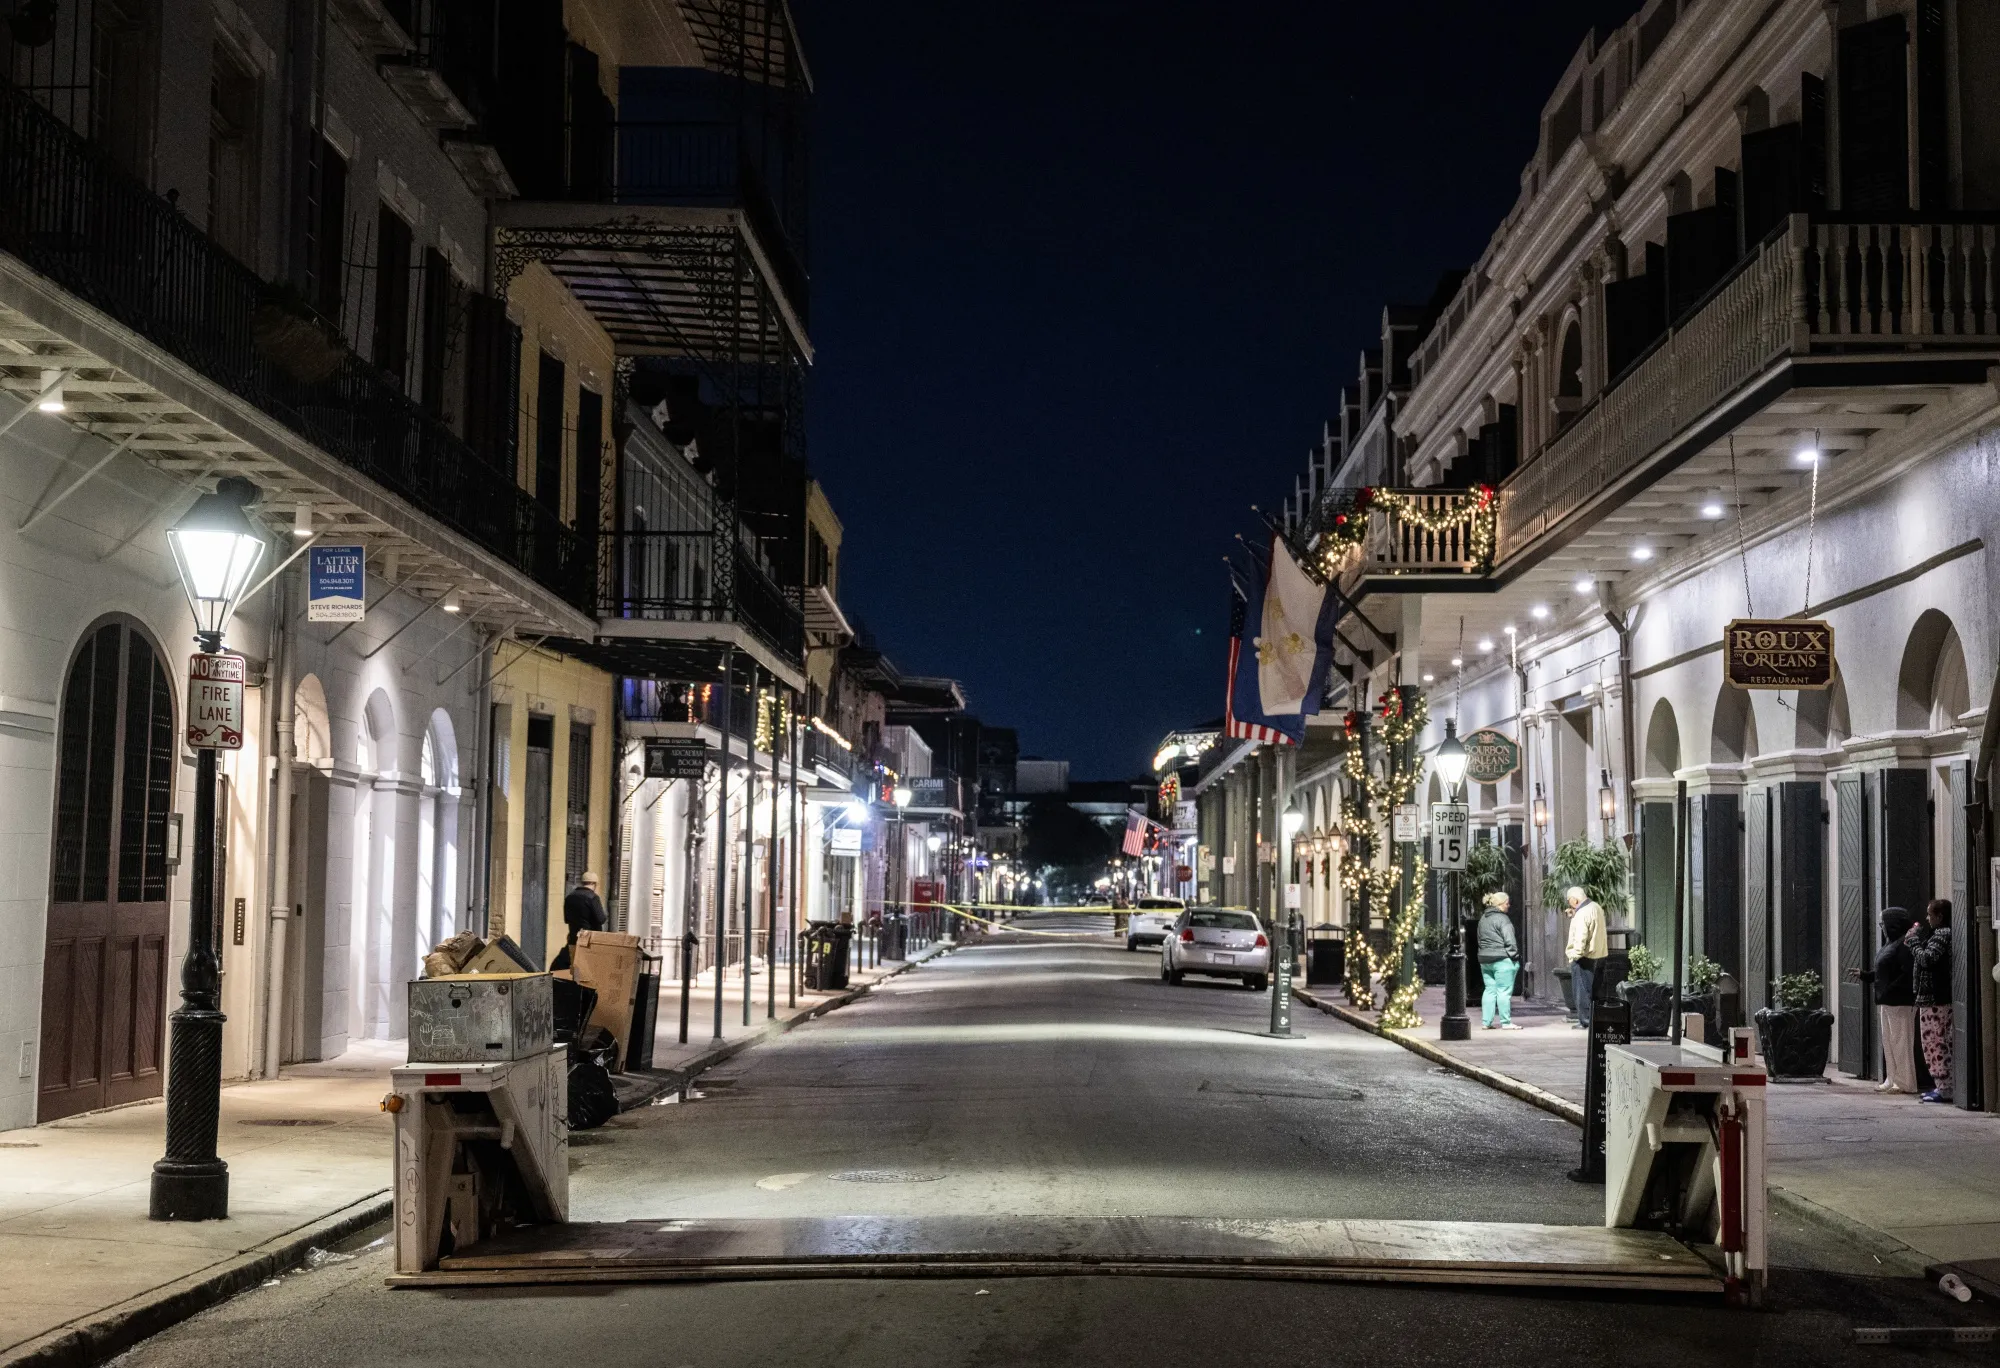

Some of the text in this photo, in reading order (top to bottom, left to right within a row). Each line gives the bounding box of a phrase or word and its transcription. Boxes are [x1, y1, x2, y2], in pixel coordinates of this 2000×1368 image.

[317, 556, 359, 565] LATTER
[326, 564, 355, 573] BLUM
[1733, 630, 1826, 650] ROUX
[191, 658, 209, 676] NO
[210, 659, 242, 670] SOPPING
[1743, 650, 1817, 675] ORLEANS
[211, 670, 240, 679] ANYTIME
[1750, 676, 1810, 684] RESTAURANT
[202, 685, 230, 702] FIRE
[199, 705, 232, 722] LANE
[1464, 744, 1510, 755] BOURBON
[1468, 754, 1510, 765] ORLEANS
[1468, 764, 1506, 773] HOTEL
[912, 779, 943, 788] CARIMI
[1435, 811, 1466, 823] SPEED
[1438, 825, 1463, 836] LIMIT
[1438, 838, 1461, 863] 15
